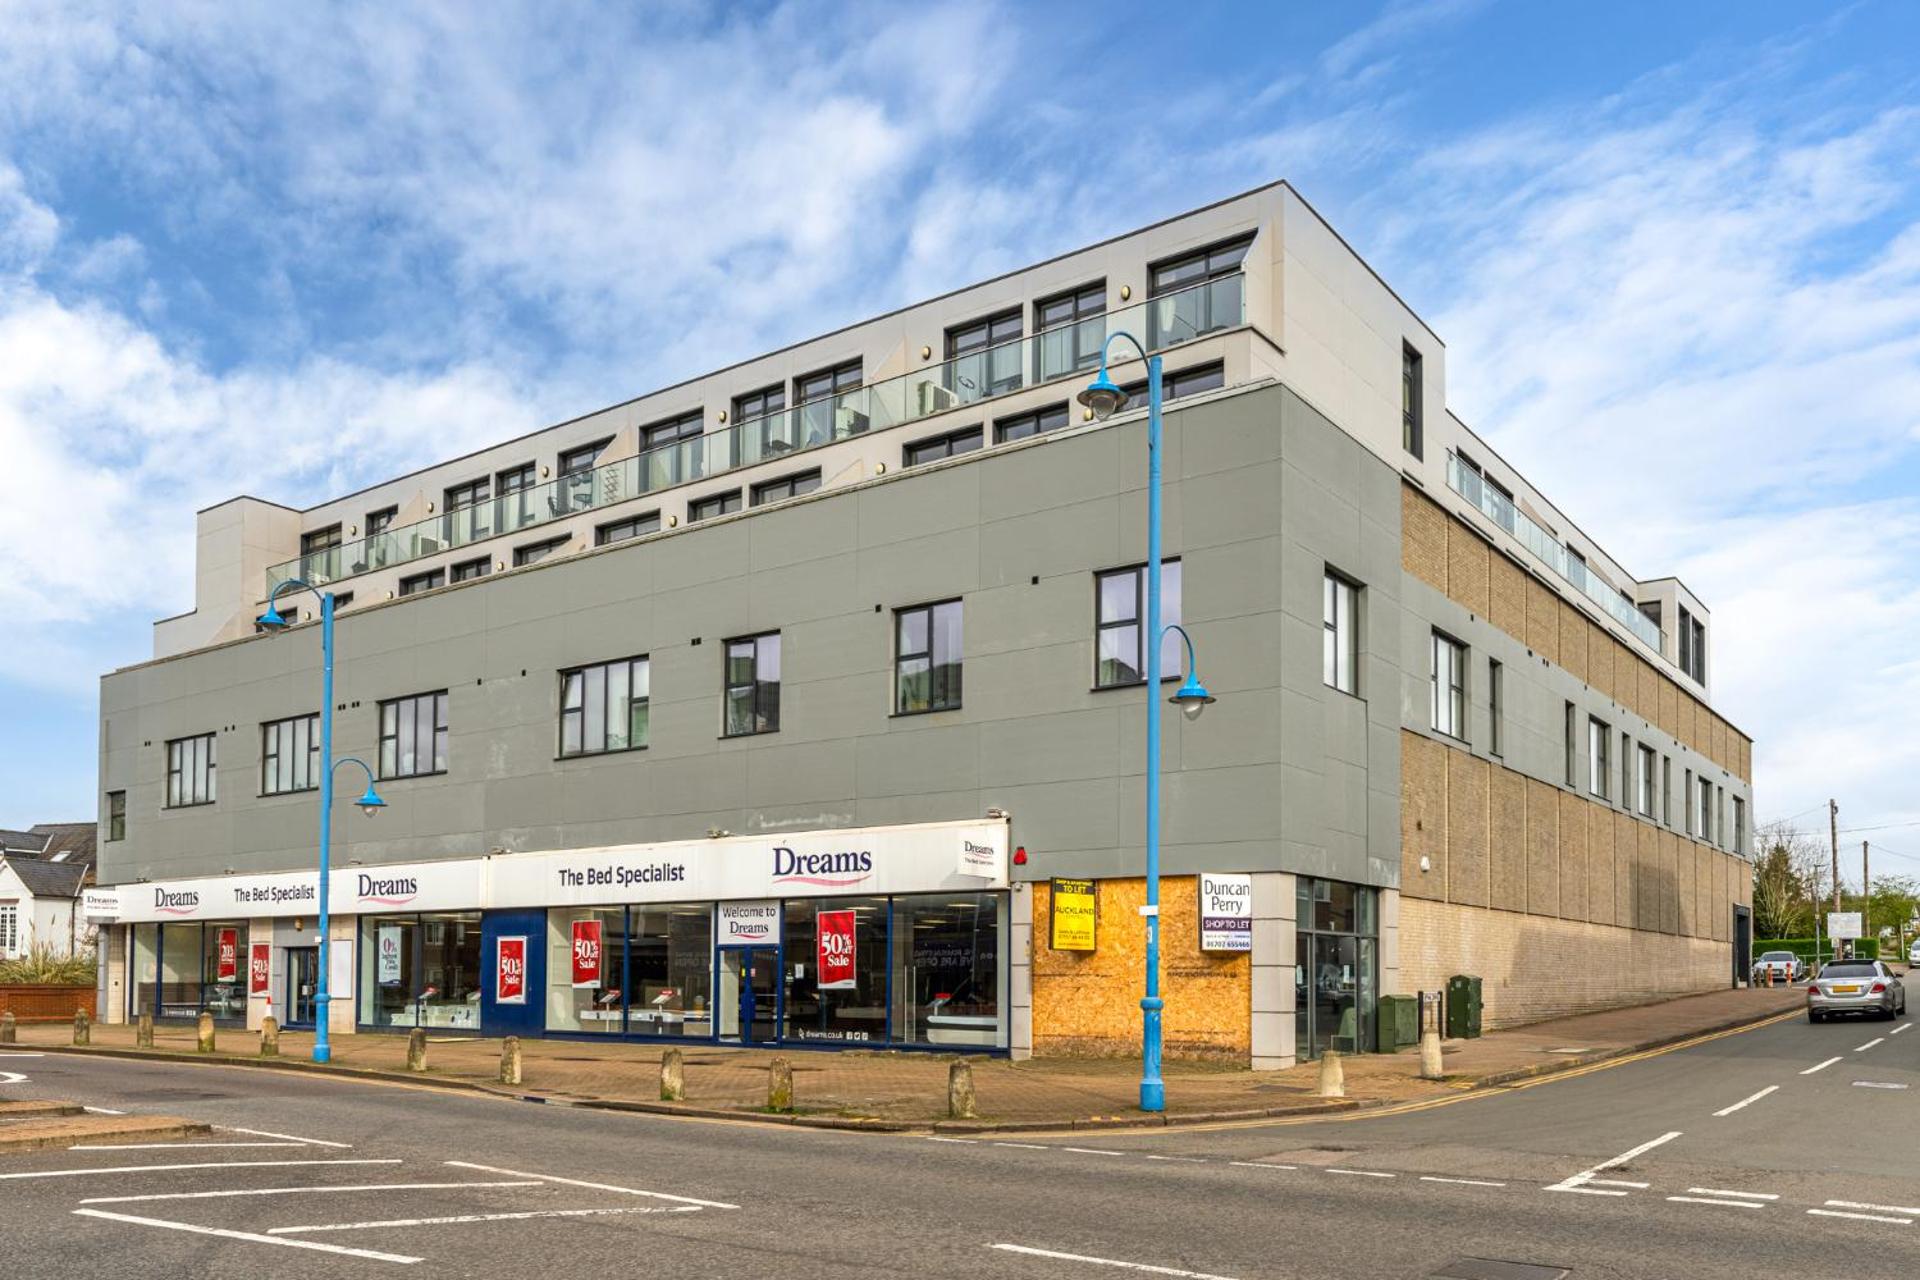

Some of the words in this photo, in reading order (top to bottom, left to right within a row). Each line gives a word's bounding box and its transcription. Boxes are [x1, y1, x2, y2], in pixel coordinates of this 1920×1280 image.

[964, 840, 994, 855] Dreams
[772, 847, 872, 876] Dreams
[558, 868, 584, 886] The
[587, 865, 612, 885] Bed
[616, 863, 684, 888] Specialist
[358, 873, 417, 897] Dreams
[1063, 885, 1074, 893] TO
[1074, 886, 1087, 894] LET
[1204, 879, 1250, 896] Duncan
[87, 895, 118, 904] Dreams
[155, 888, 199, 907] Dreams
[234, 888, 250, 902] The
[253, 886, 269, 901] Bed
[271, 884, 314, 904] Specialist
[722, 907, 764, 918] Welcome
[766, 906, 776, 917] to
[1056, 905, 1094, 915] AUCKLAND
[1211, 896, 1243, 915] Perry
[729, 921, 769, 934] Dreams
[1205, 919, 1225, 928] SHOP
[1225, 920, 1236, 928] TO
[1237, 920, 1249, 928] LET
[574, 938, 599, 959] 50%
[820, 933, 852, 956] 50%
[579, 959, 596, 969] Sale
[827, 954, 849, 967] Sale
[505, 975, 520, 984] Sale
